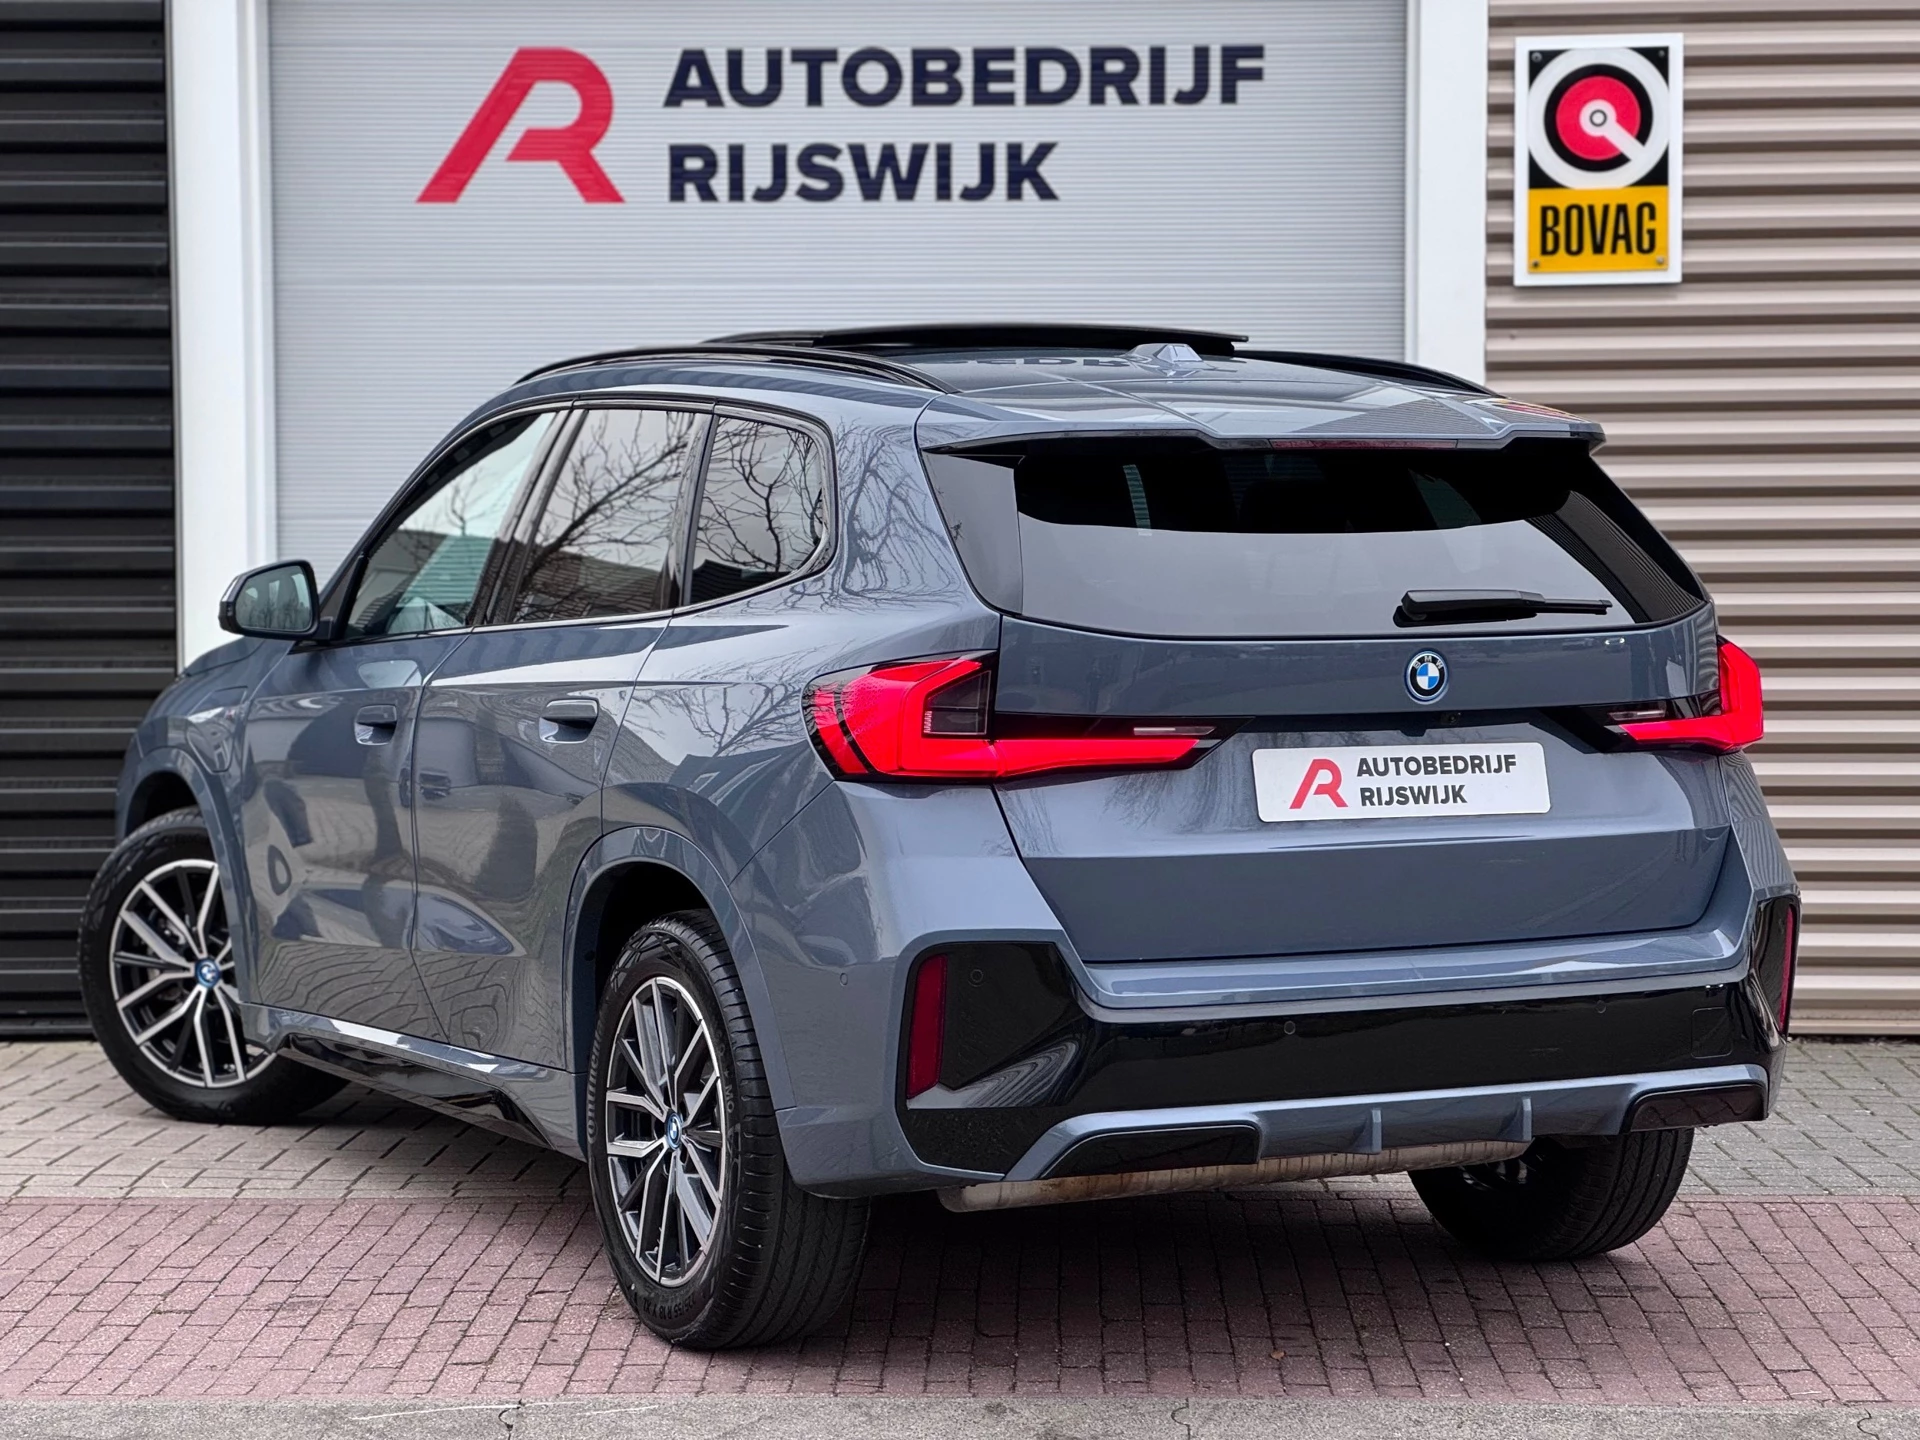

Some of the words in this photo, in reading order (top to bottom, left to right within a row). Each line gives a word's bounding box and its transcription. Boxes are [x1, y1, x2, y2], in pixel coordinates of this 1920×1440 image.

[663, 44, 1265, 108] AUTOBEDRIJF
[668, 141, 1060, 203] RIJSWIJK
[1540, 202, 1656, 257] BOVAG
[1412, 655, 1443, 670] BMW
[1356, 754, 1517, 777] AUTOBEDRIJF
[1359, 785, 1468, 807] RIJSWIJK
